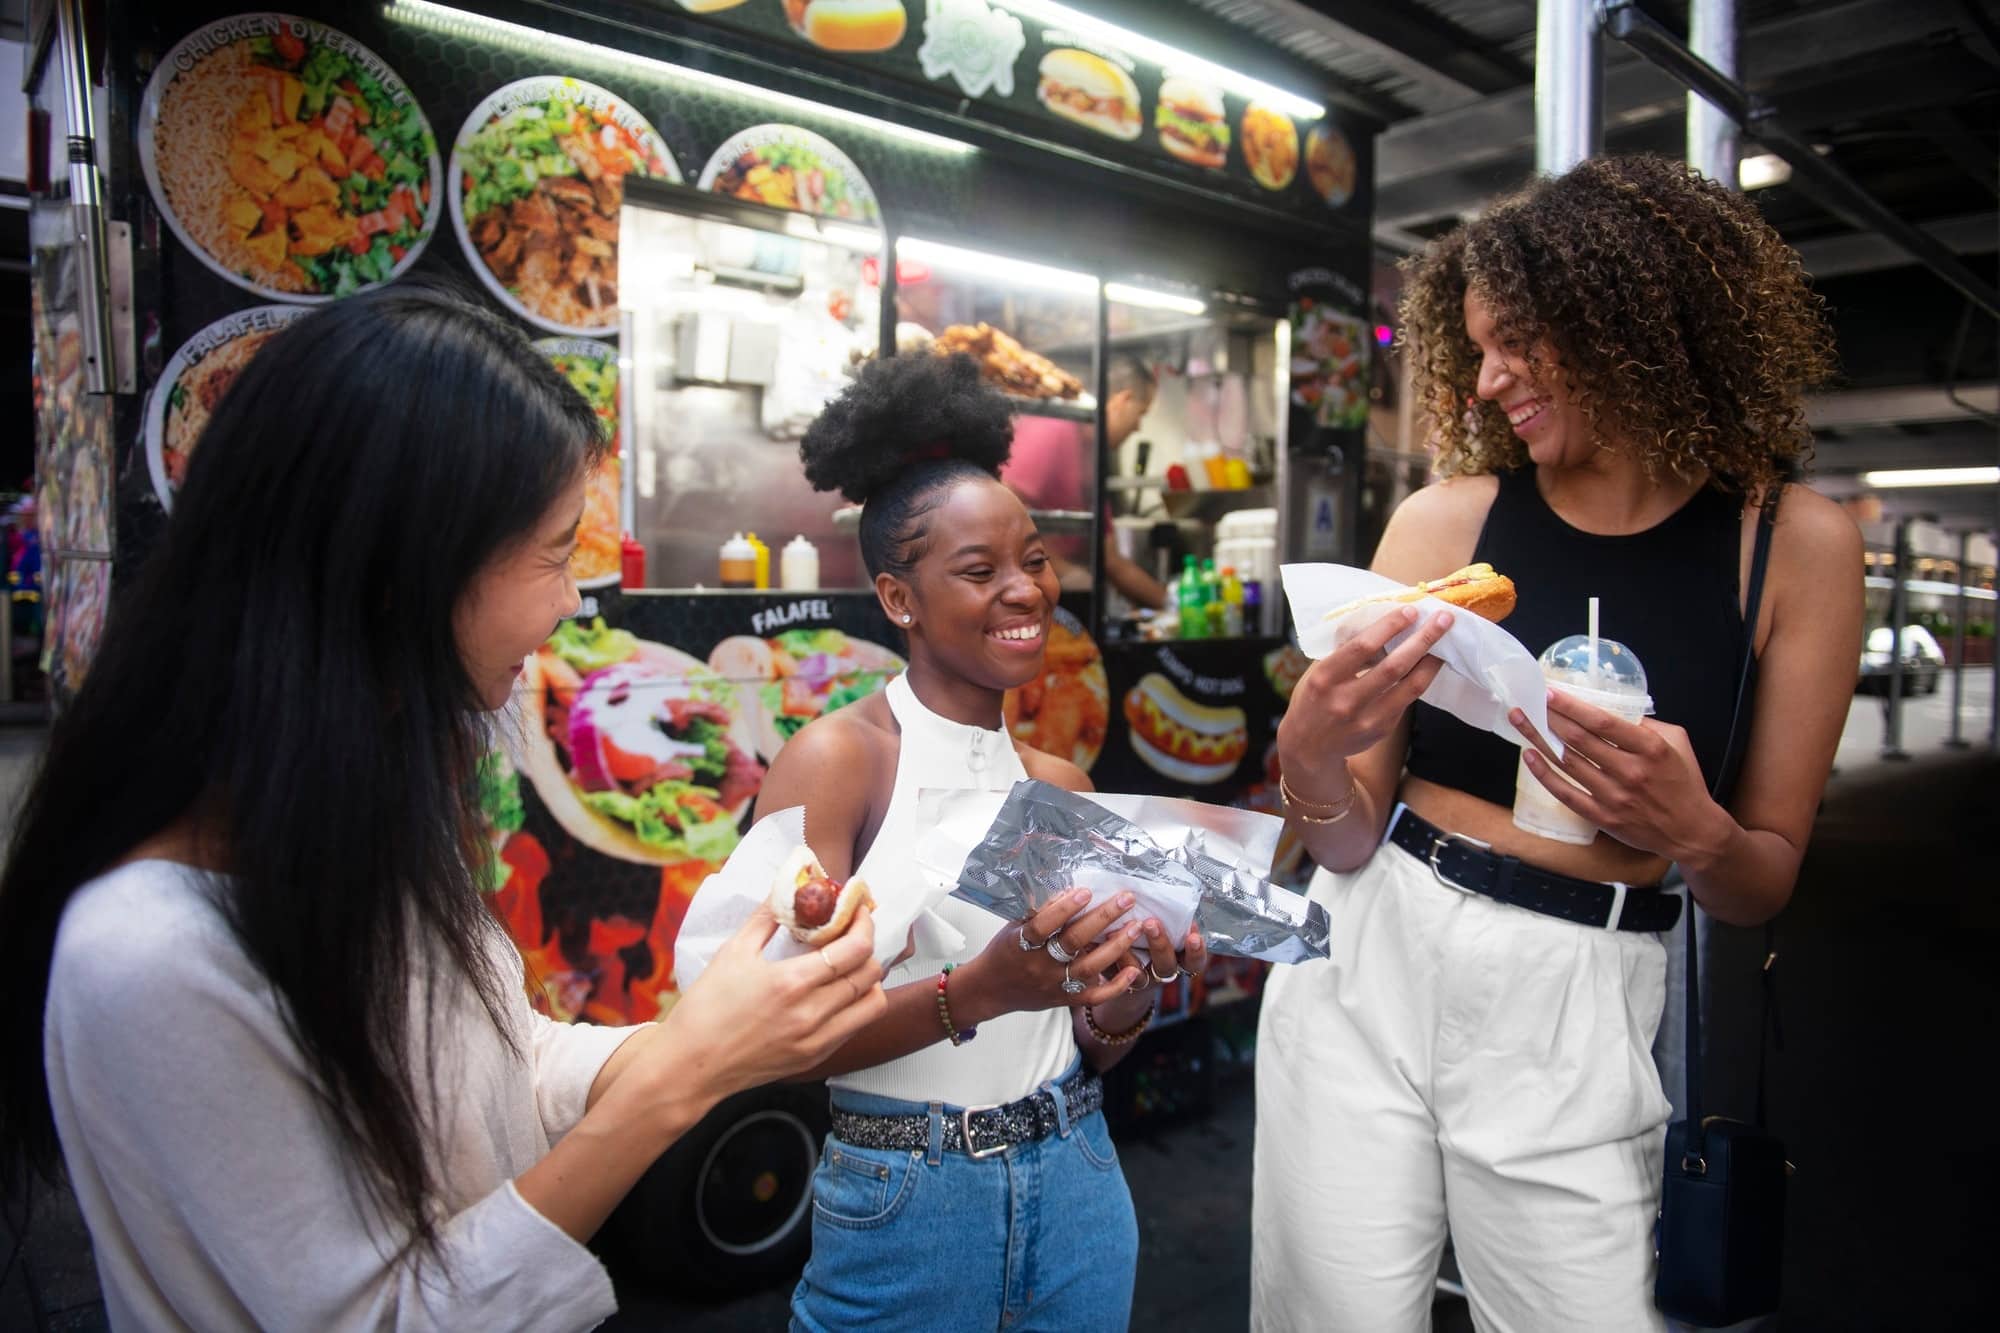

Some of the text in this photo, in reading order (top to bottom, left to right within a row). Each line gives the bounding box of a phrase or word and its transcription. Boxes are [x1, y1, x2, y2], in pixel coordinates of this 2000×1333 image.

[173, 17, 412, 106] CHICKEN OVER RICE
[488, 82, 549, 117] LAMB
[557, 86, 609, 112] OVER
[181, 309, 281, 367] FALAFEL
[558, 341, 605, 361] OVER
[1315, 498, 1334, 532] A
[751, 599, 832, 635] FALAFEL
[1195, 676, 1218, 694] HOT
